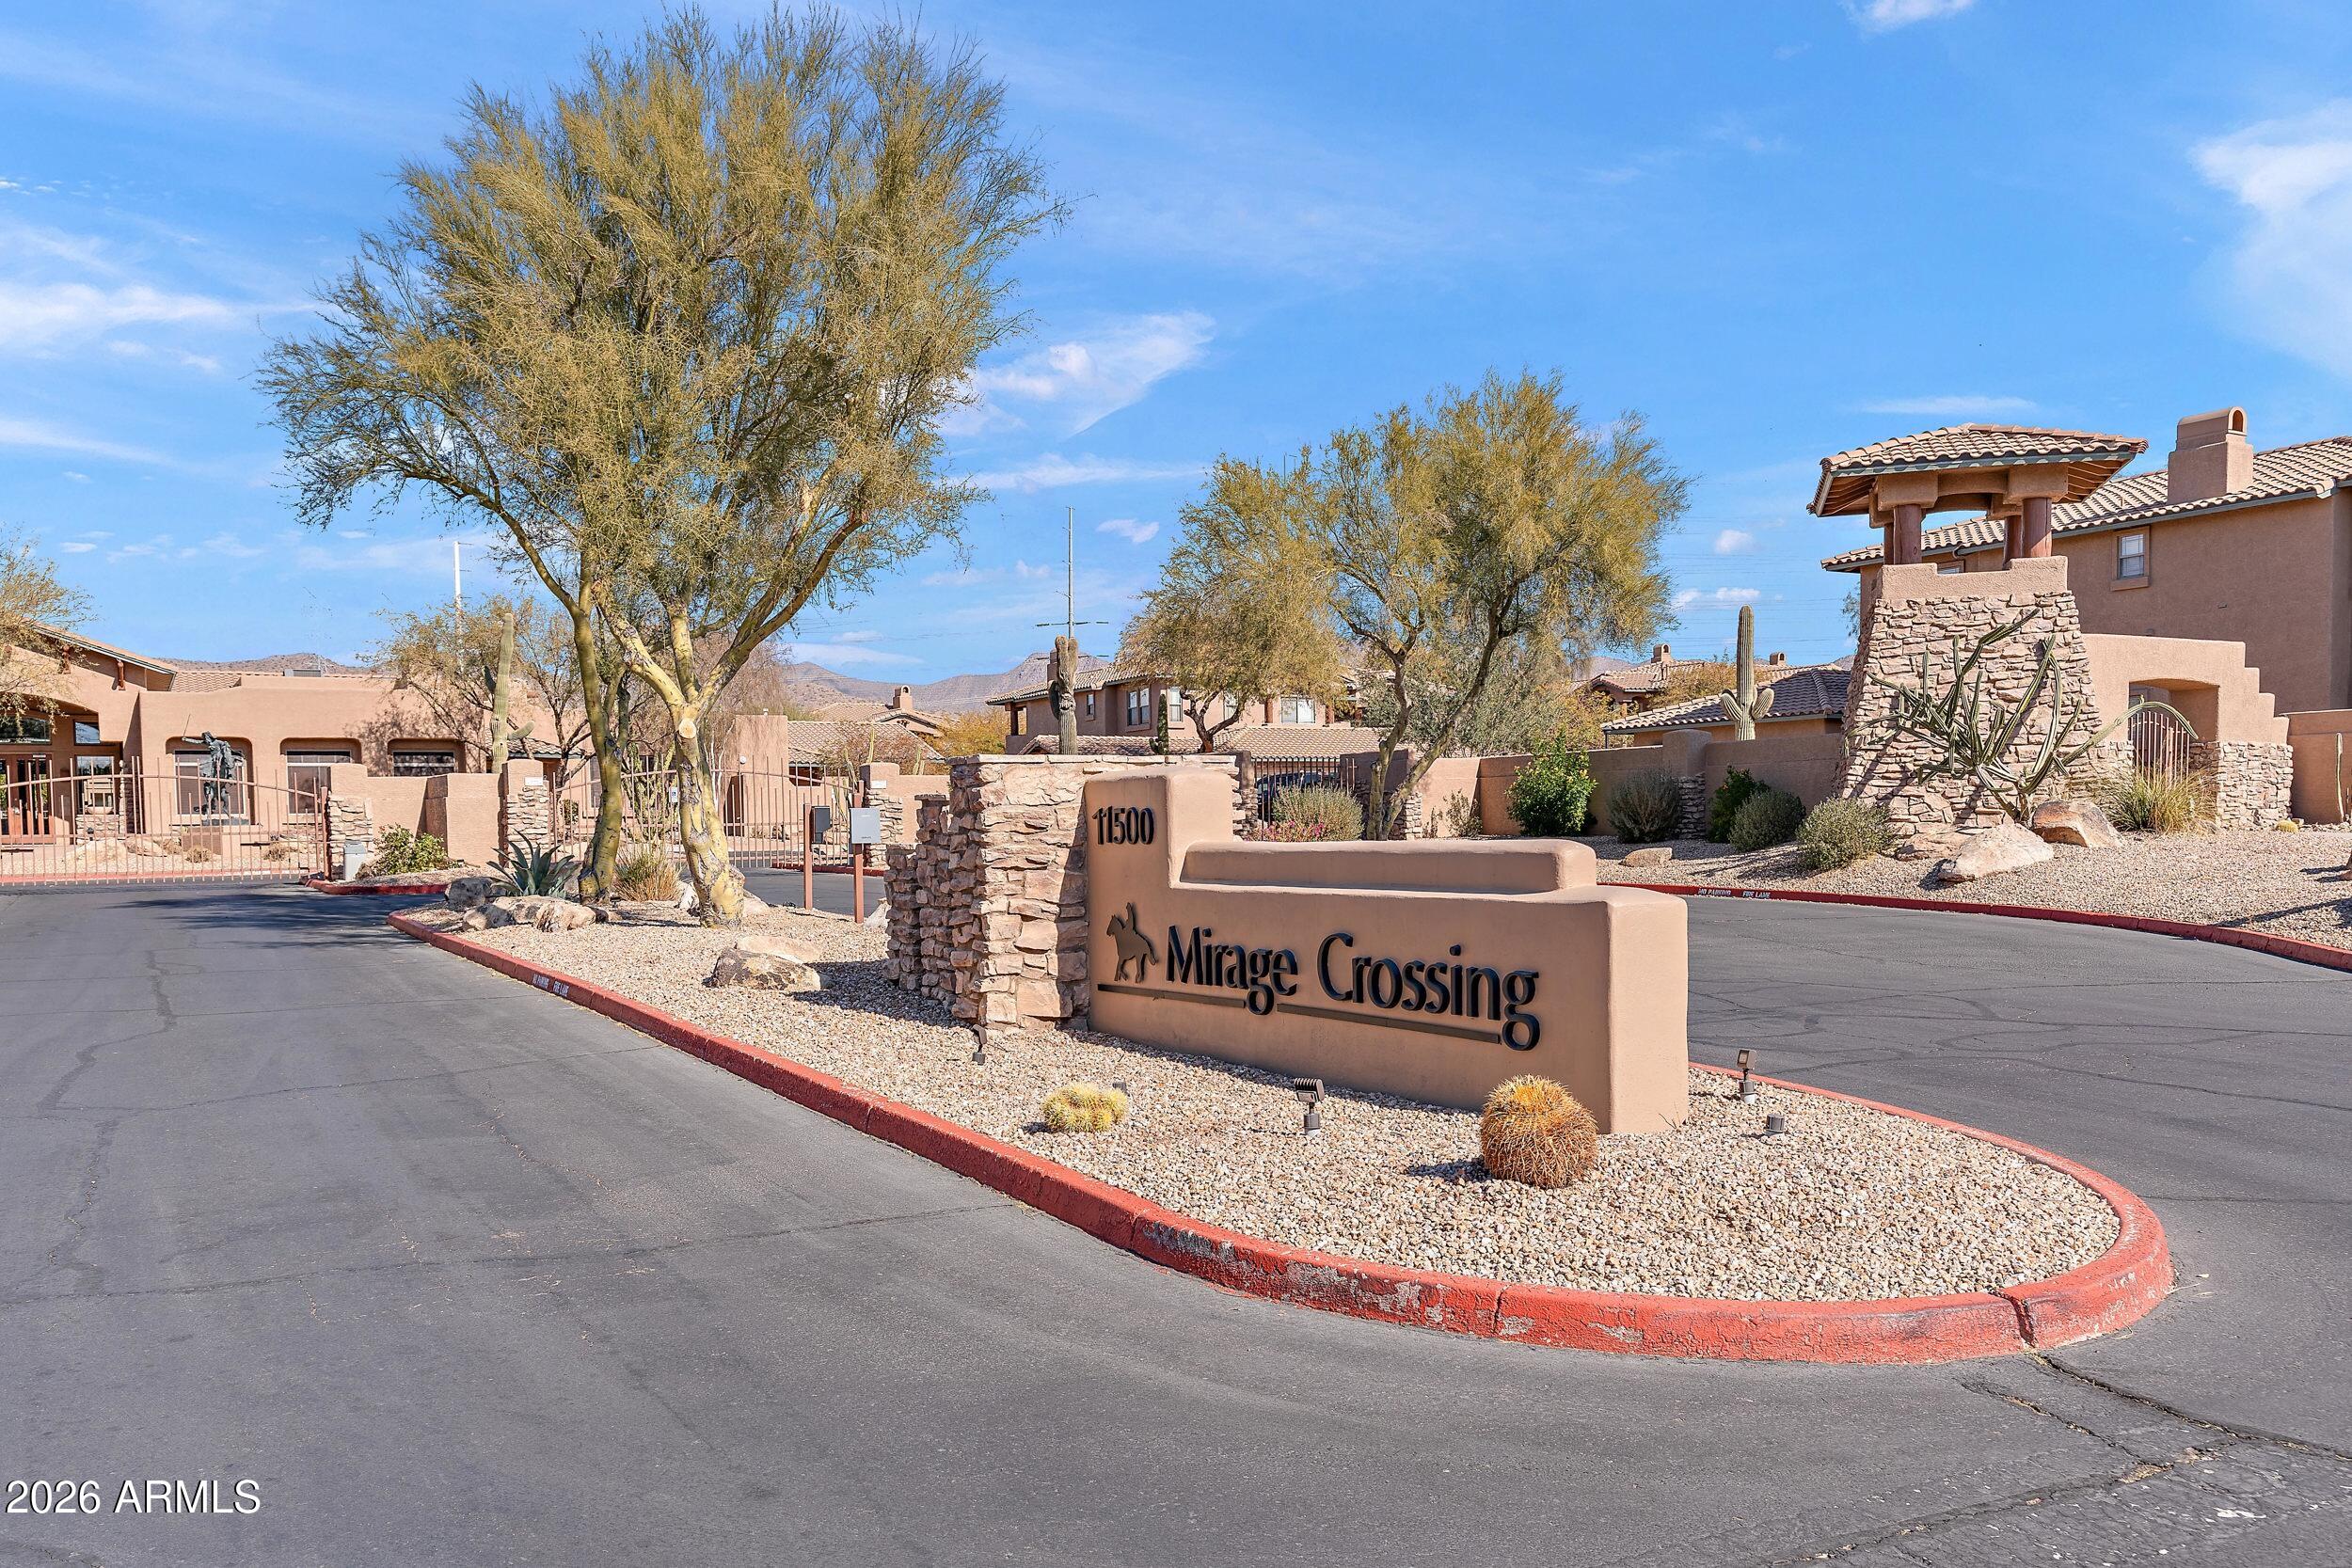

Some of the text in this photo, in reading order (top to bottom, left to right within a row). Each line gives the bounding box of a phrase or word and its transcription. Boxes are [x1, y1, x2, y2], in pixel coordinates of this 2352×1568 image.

[1092, 806, 1154, 845] 11500
[1166, 926, 1541, 1052] Mirage Crossing
